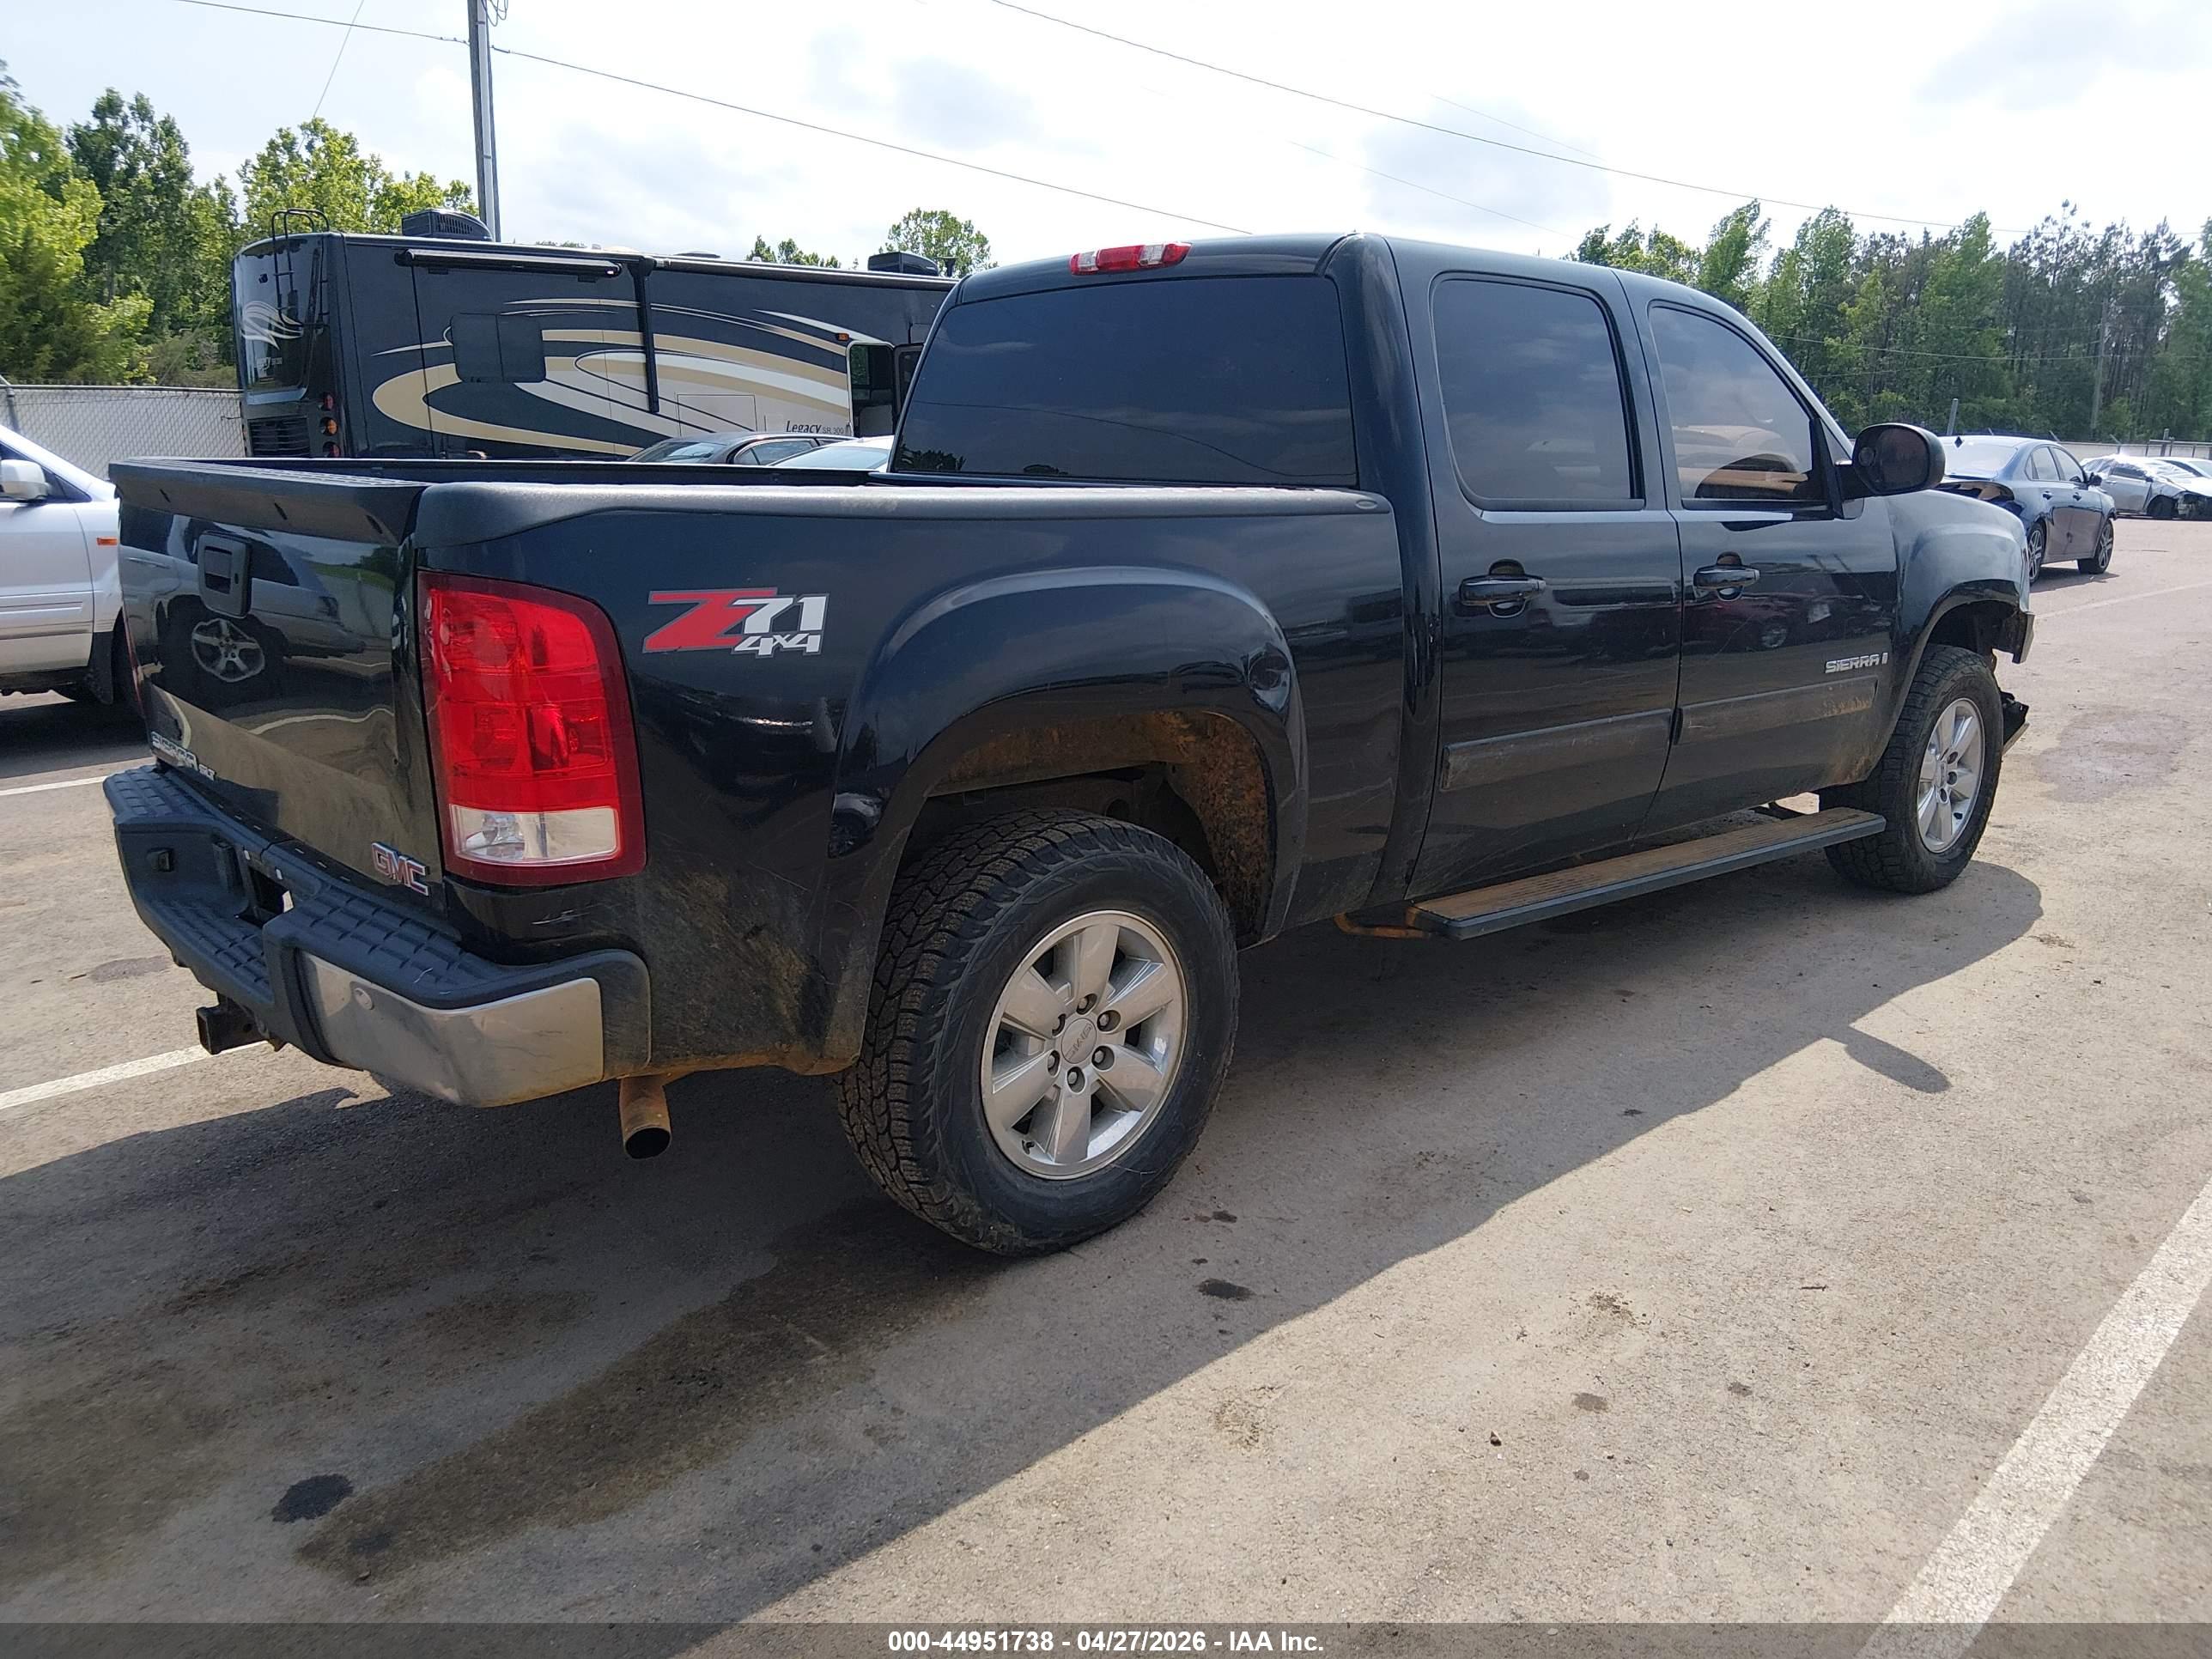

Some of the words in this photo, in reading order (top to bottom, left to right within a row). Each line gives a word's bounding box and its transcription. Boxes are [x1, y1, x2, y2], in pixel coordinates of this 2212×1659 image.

[786, 420, 822, 434] Legacy
[644, 587, 828, 652] Z71
[1825, 654, 1880, 673] SIERRA
[371, 842, 428, 896] GMC
